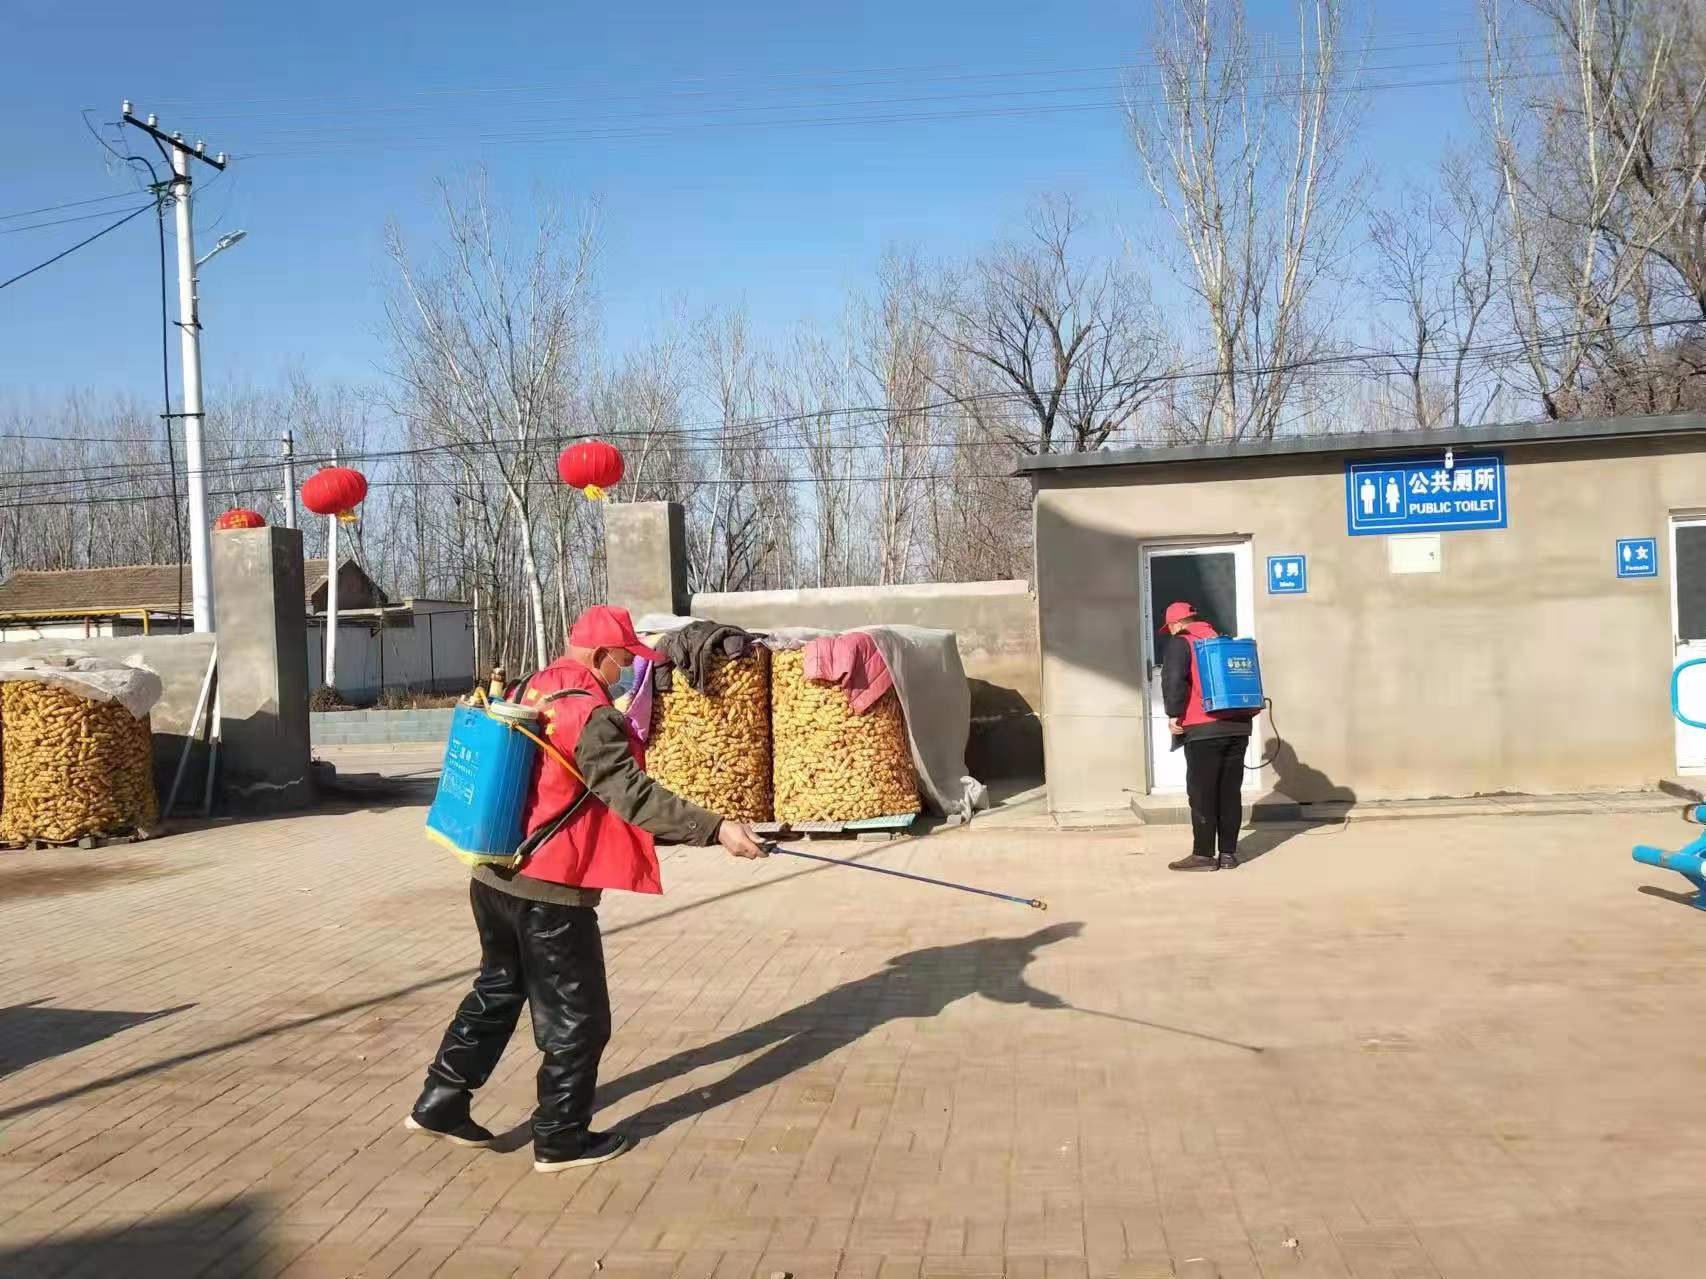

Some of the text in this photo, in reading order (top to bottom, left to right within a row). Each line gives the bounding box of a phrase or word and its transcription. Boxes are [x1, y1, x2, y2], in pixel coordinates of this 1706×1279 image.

[1408, 468, 1495, 494] 公共厕所
[1409, 499, 1495, 514] PUBLIC TOILET
